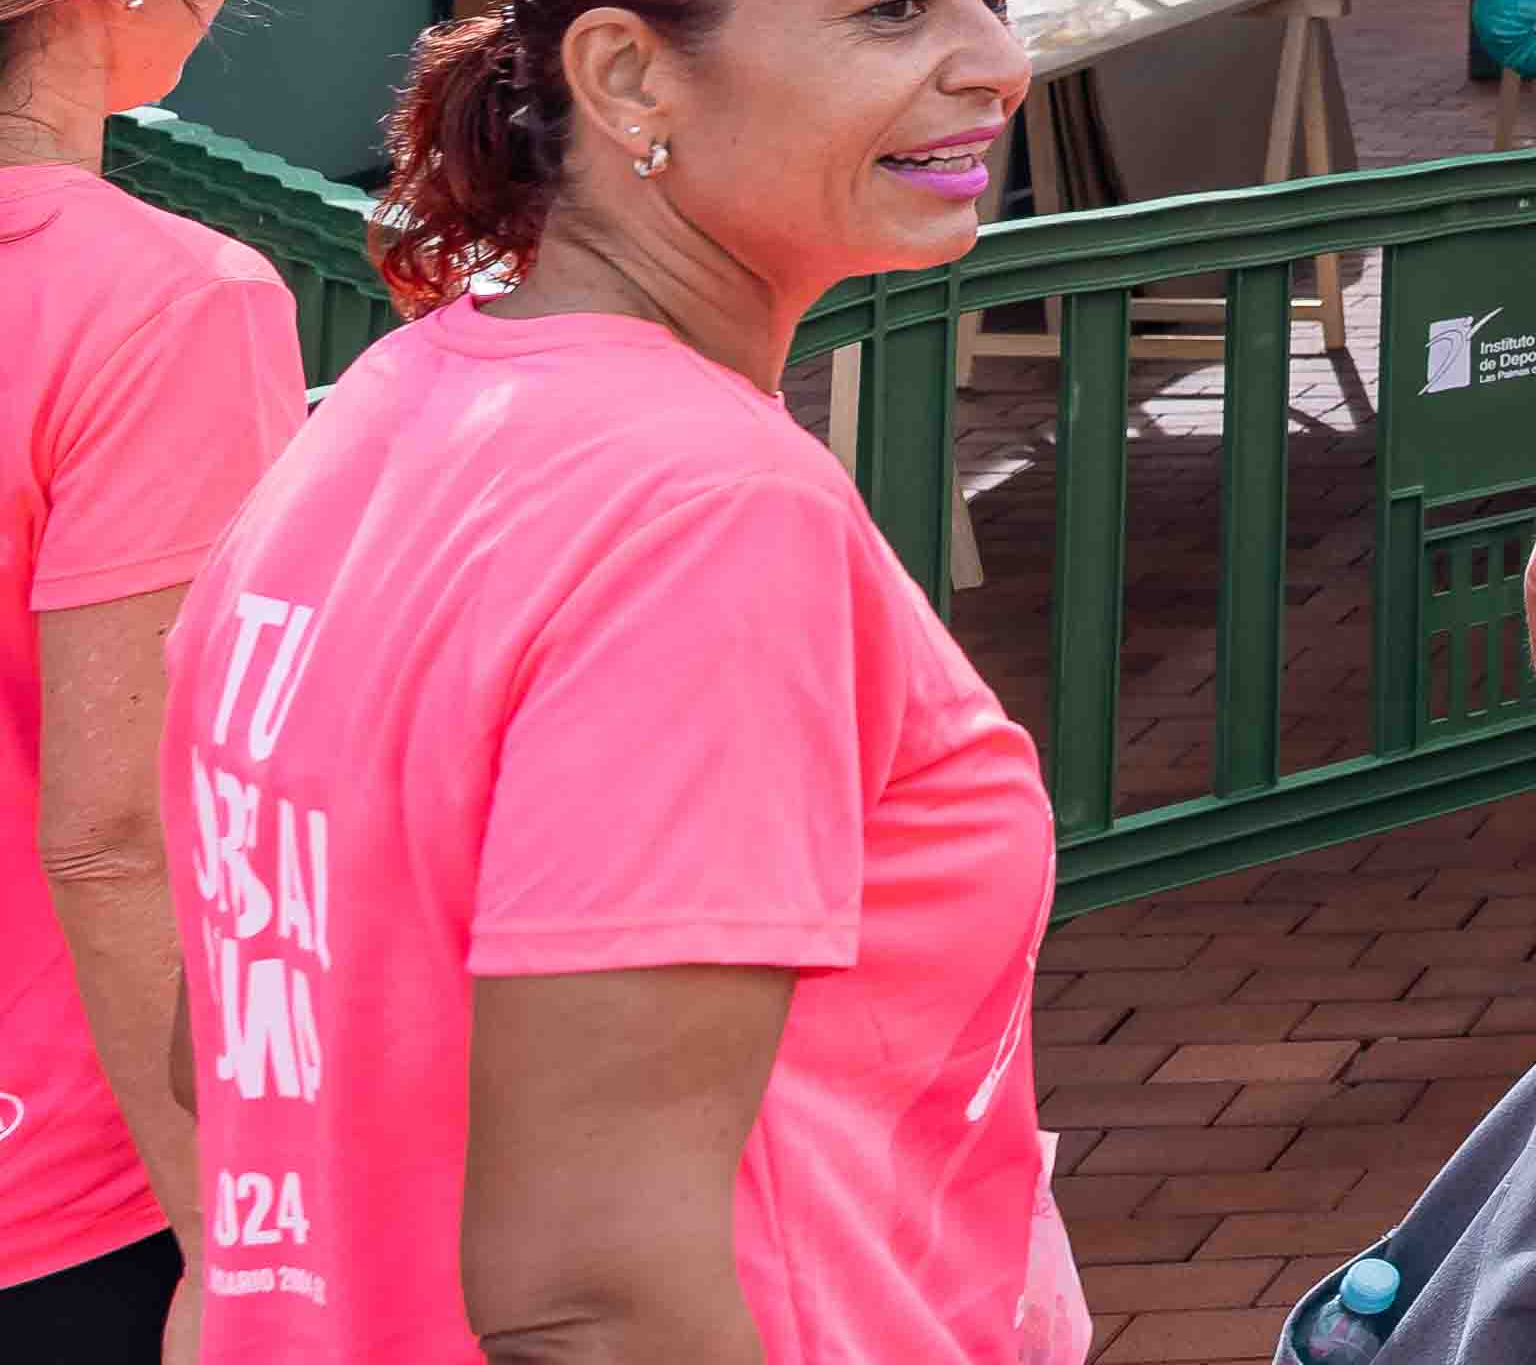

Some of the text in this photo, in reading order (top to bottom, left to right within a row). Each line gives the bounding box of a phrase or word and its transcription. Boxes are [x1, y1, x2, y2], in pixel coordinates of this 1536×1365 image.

[1480, 333, 1535, 355] Instituto
[1480, 358, 1497, 372] de
[212, 591, 314, 762] TU
